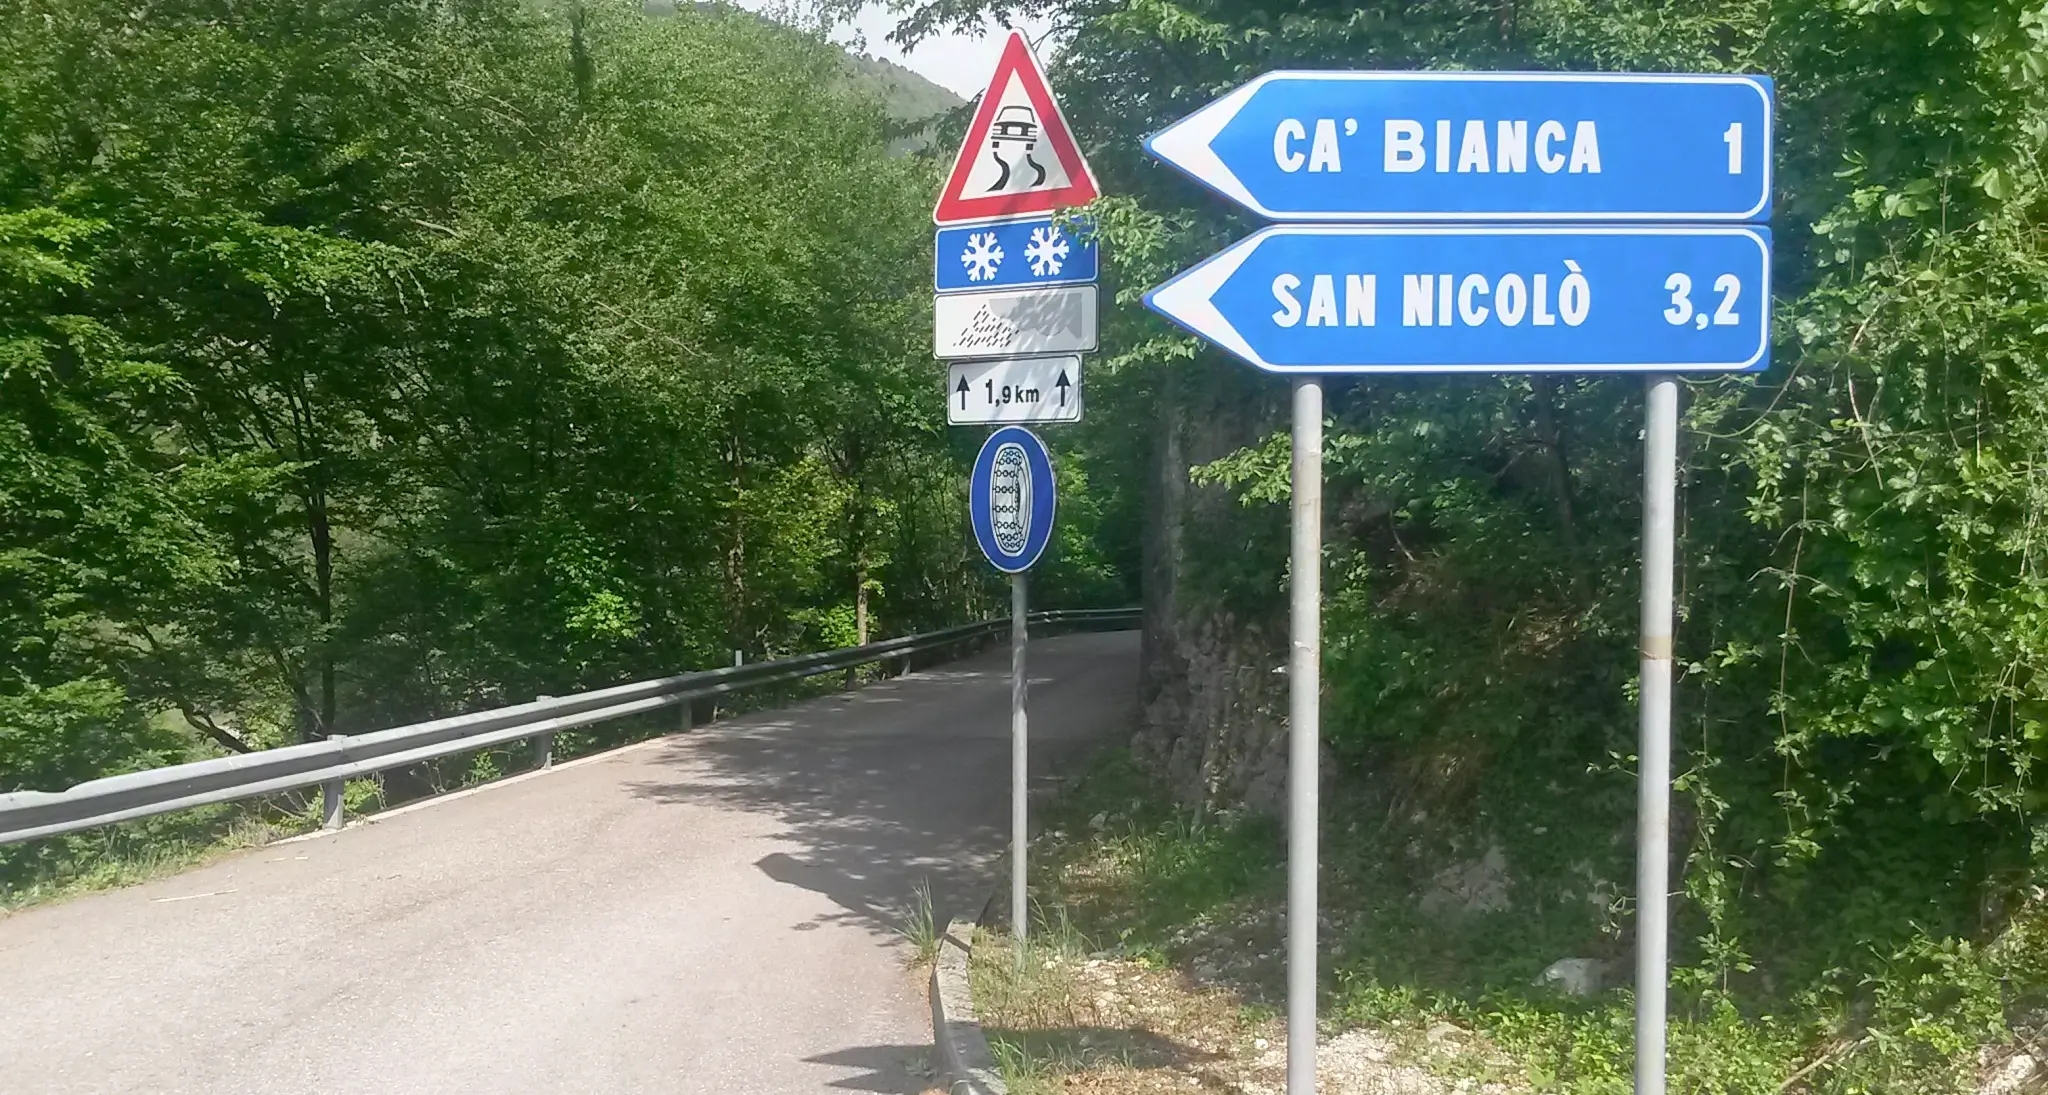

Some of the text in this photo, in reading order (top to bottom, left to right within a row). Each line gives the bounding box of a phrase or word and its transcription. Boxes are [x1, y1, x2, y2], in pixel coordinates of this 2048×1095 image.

[1383, 119, 1602, 174] BIANCA
[1723, 122, 1743, 175] 1
[1271, 259, 1742, 331] SAN NICOLÒ 3,2
